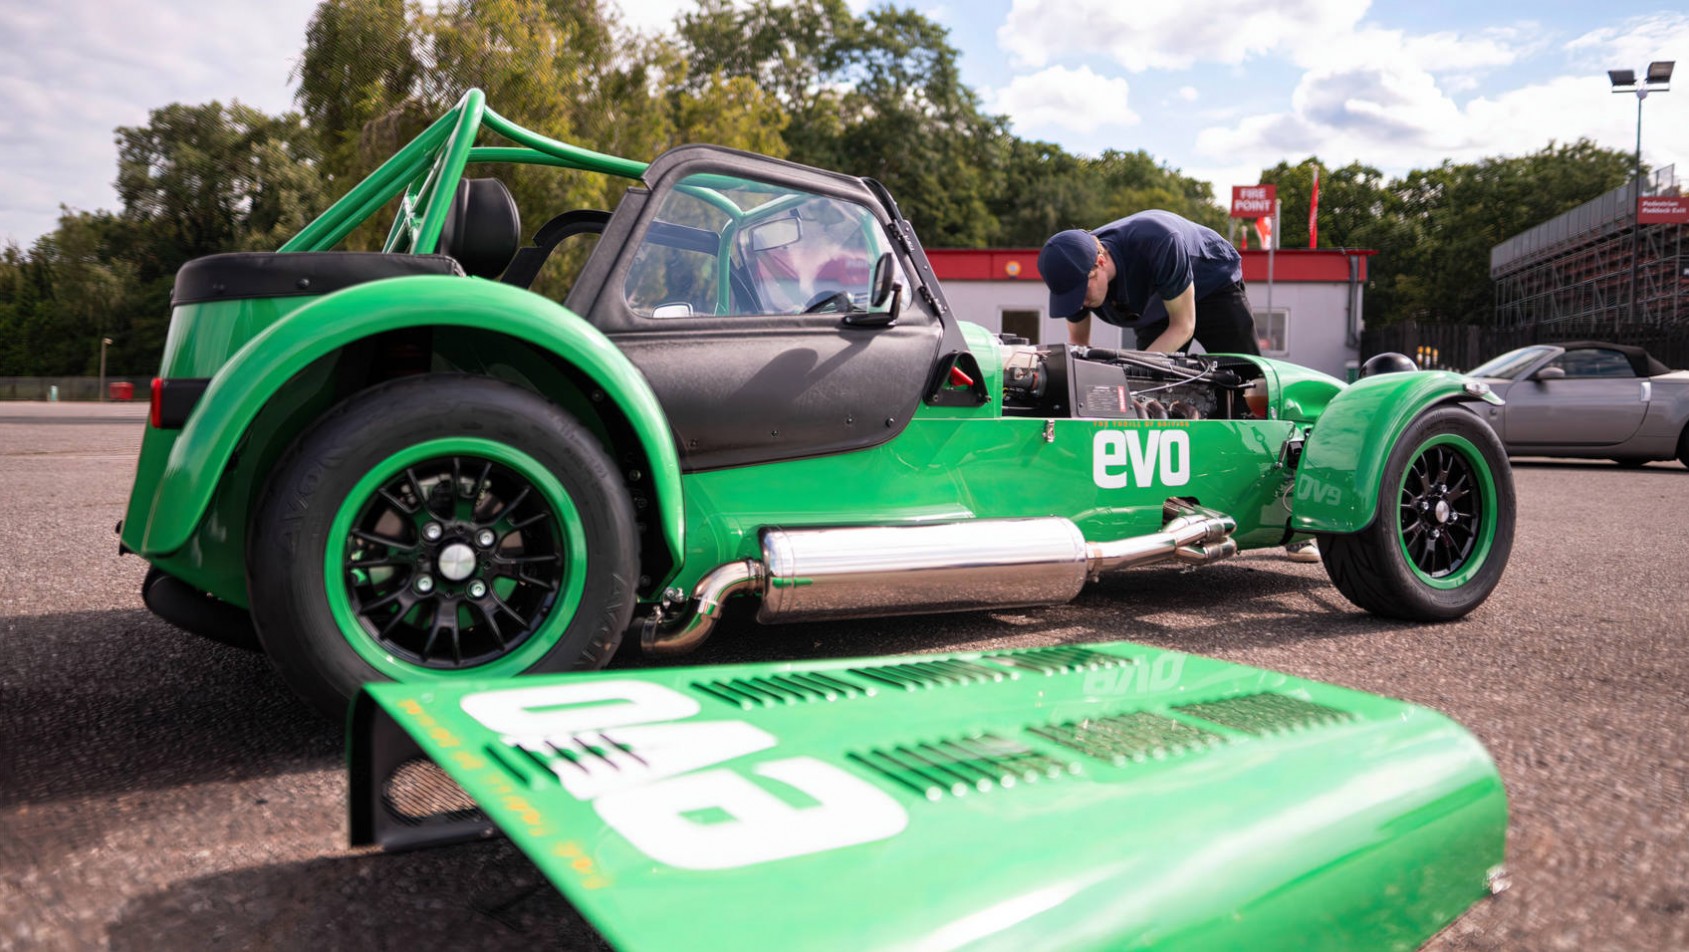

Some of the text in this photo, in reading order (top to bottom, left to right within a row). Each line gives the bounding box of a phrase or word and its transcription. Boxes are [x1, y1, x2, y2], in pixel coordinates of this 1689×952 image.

[1234, 200, 1271, 211] POINT
[1240, 188, 1266, 199] FIRE
[1093, 429, 1190, 489] evo
[459, 679, 909, 870] evo
